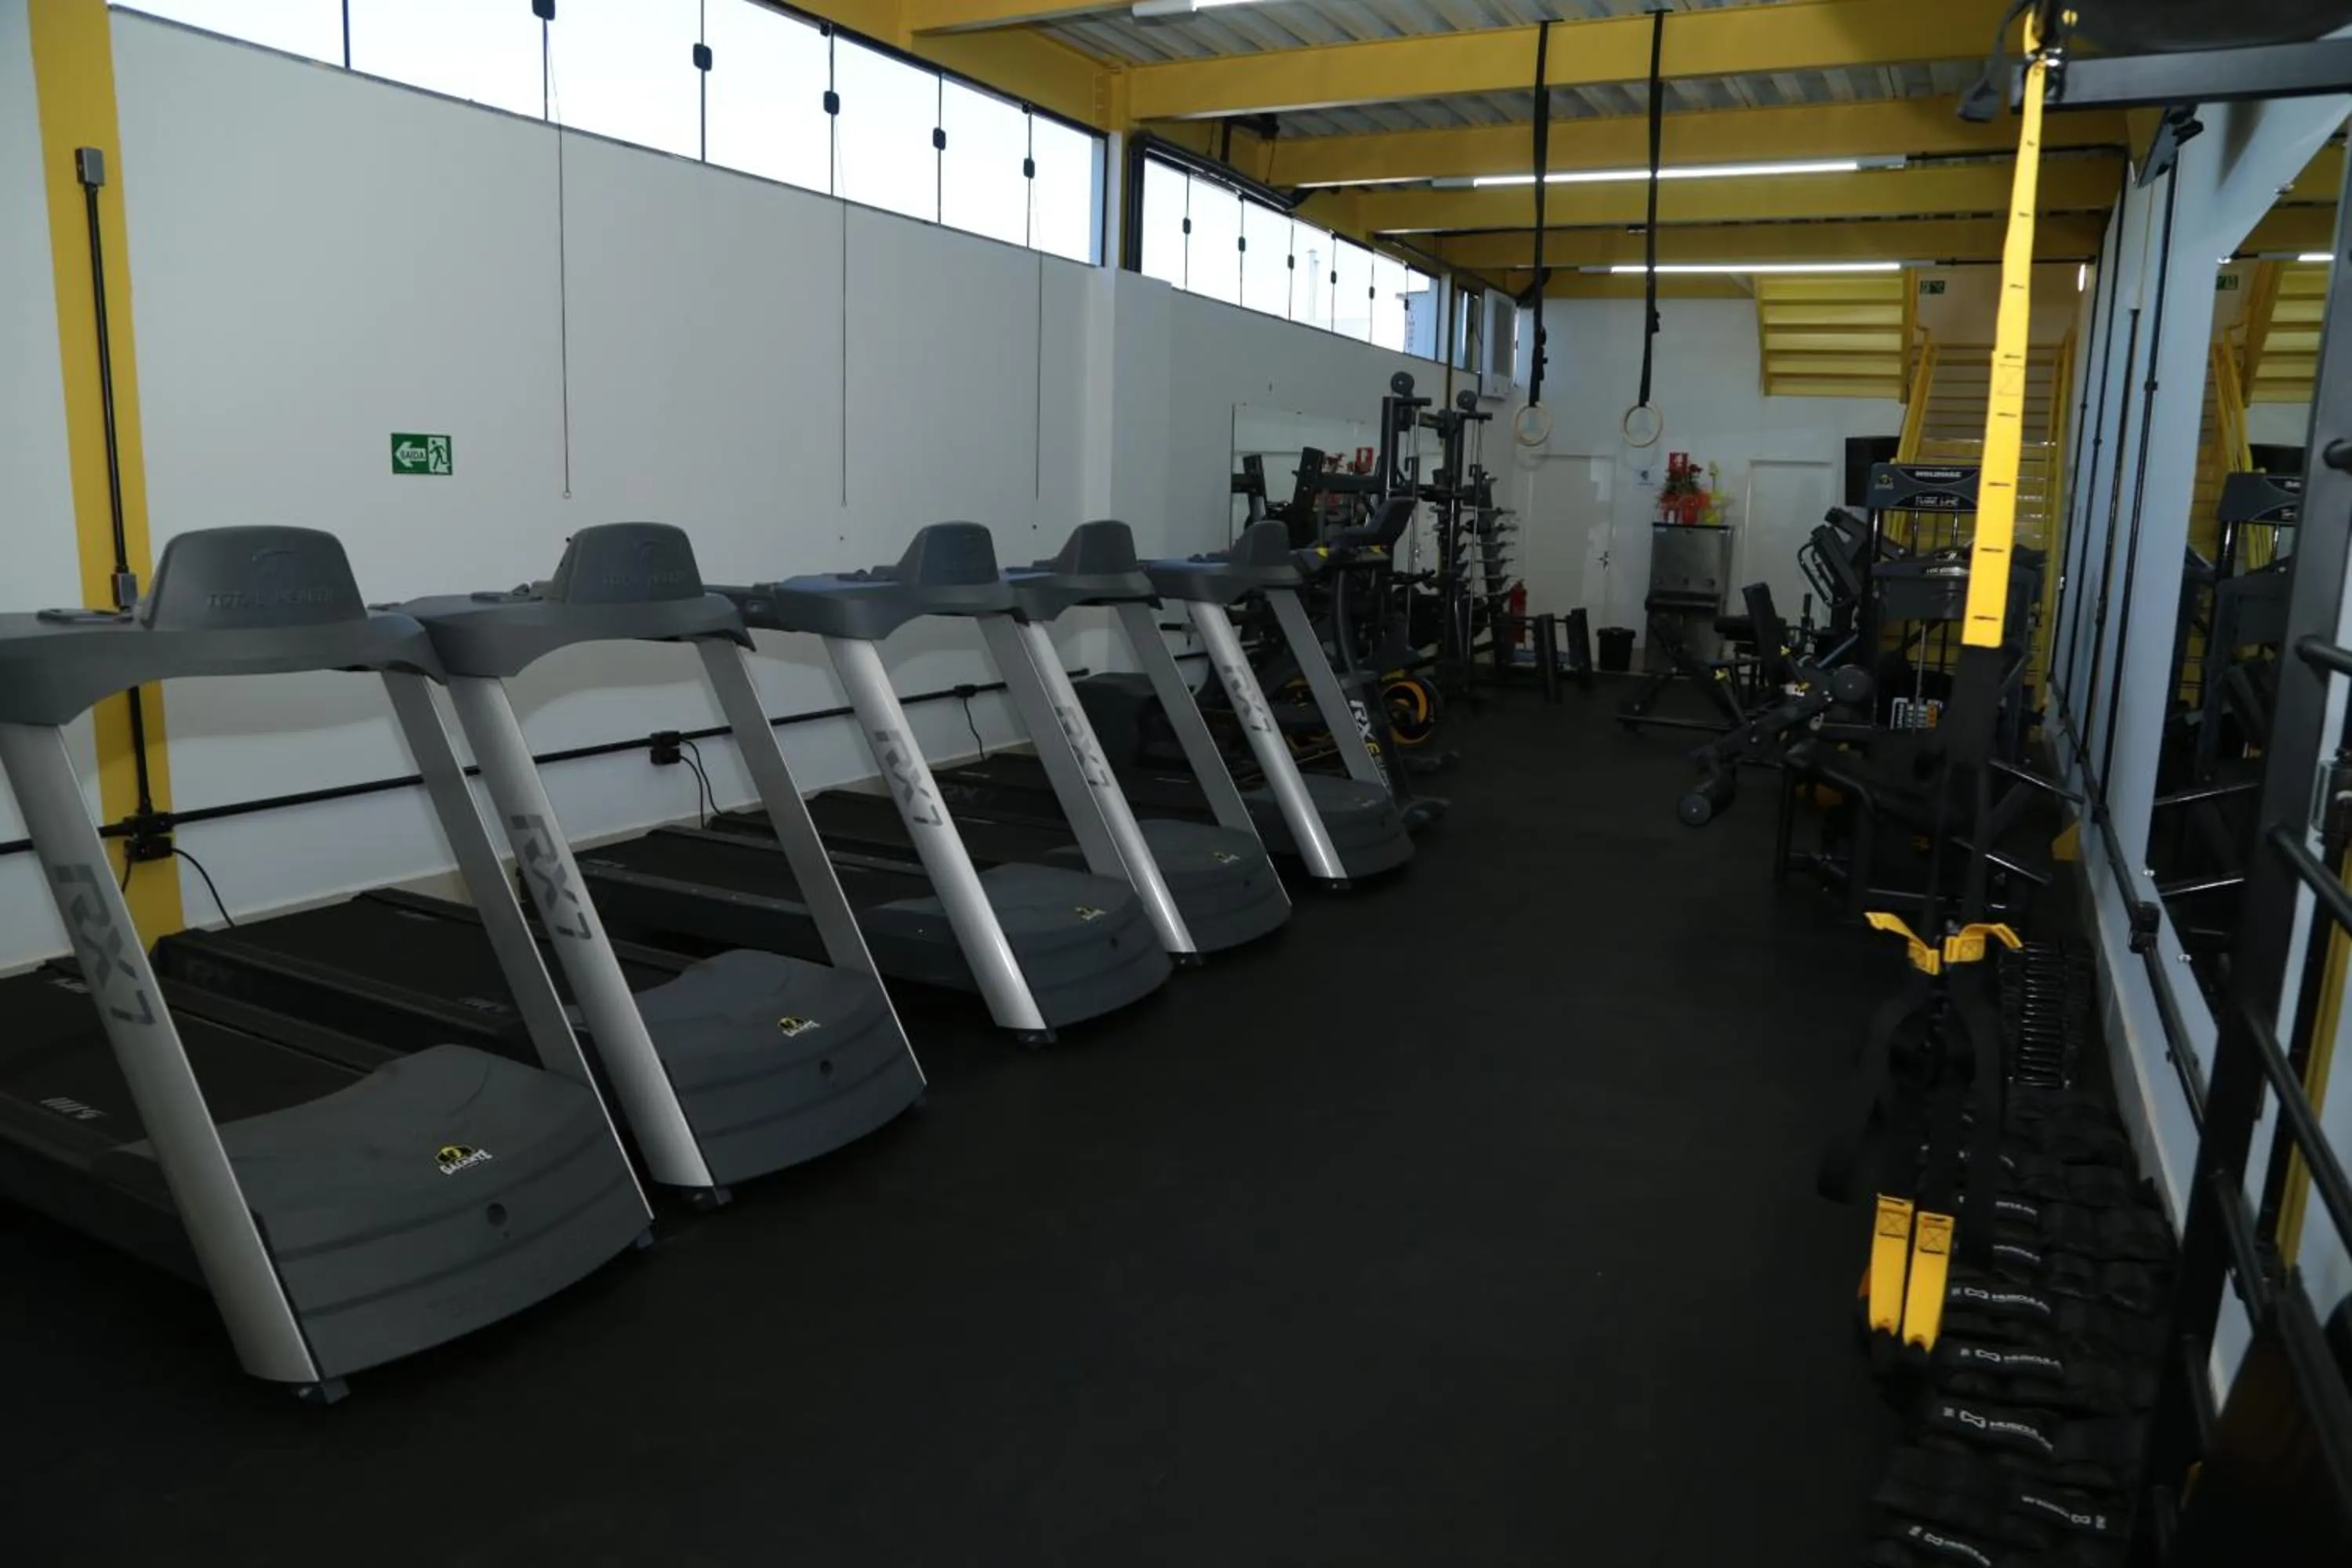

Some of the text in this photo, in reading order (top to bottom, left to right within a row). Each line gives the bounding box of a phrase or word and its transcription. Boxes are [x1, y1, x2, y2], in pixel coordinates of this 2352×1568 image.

[873, 730, 943, 826] RX7
[510, 815, 591, 939] RX7
[55, 865, 157, 1025] RX7
